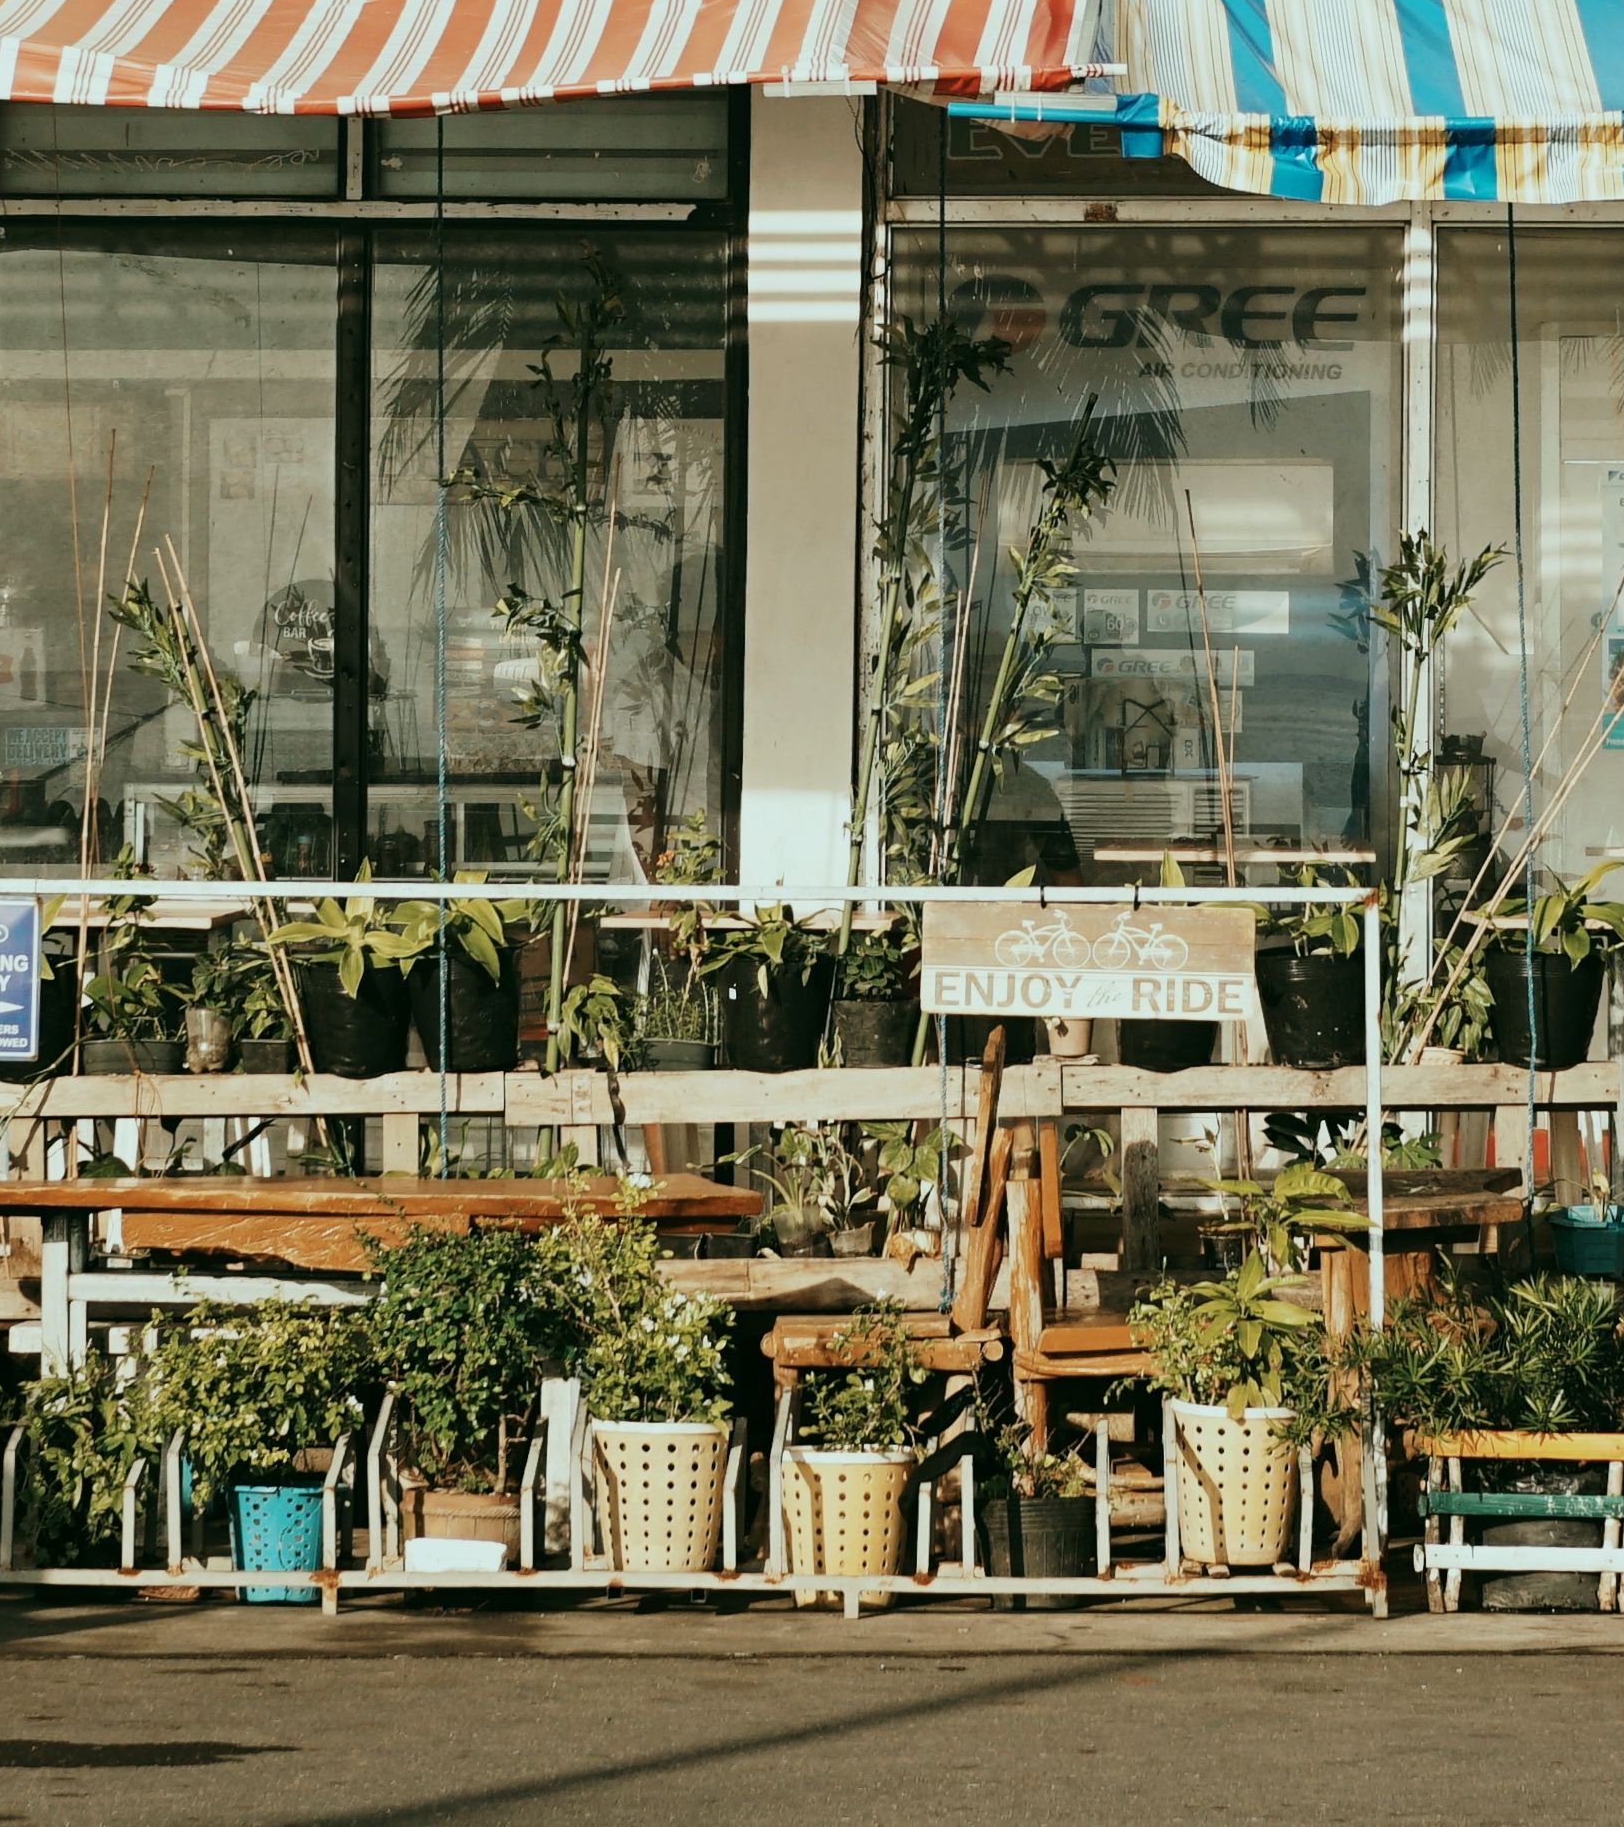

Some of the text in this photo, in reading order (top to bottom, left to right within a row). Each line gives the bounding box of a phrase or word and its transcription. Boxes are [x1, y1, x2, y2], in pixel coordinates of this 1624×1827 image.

[1059, 284, 1366, 349] GREE
[1139, 362, 1343, 380] AIR CONDITIONING
[1100, 594, 1134, 605] GREE
[274, 598, 329, 627] Coffee
[283, 626, 307, 639] BAR
[1118, 660, 1173, 673] GREE
[934, 971, 1244, 1014] ENJOY the RIDE
